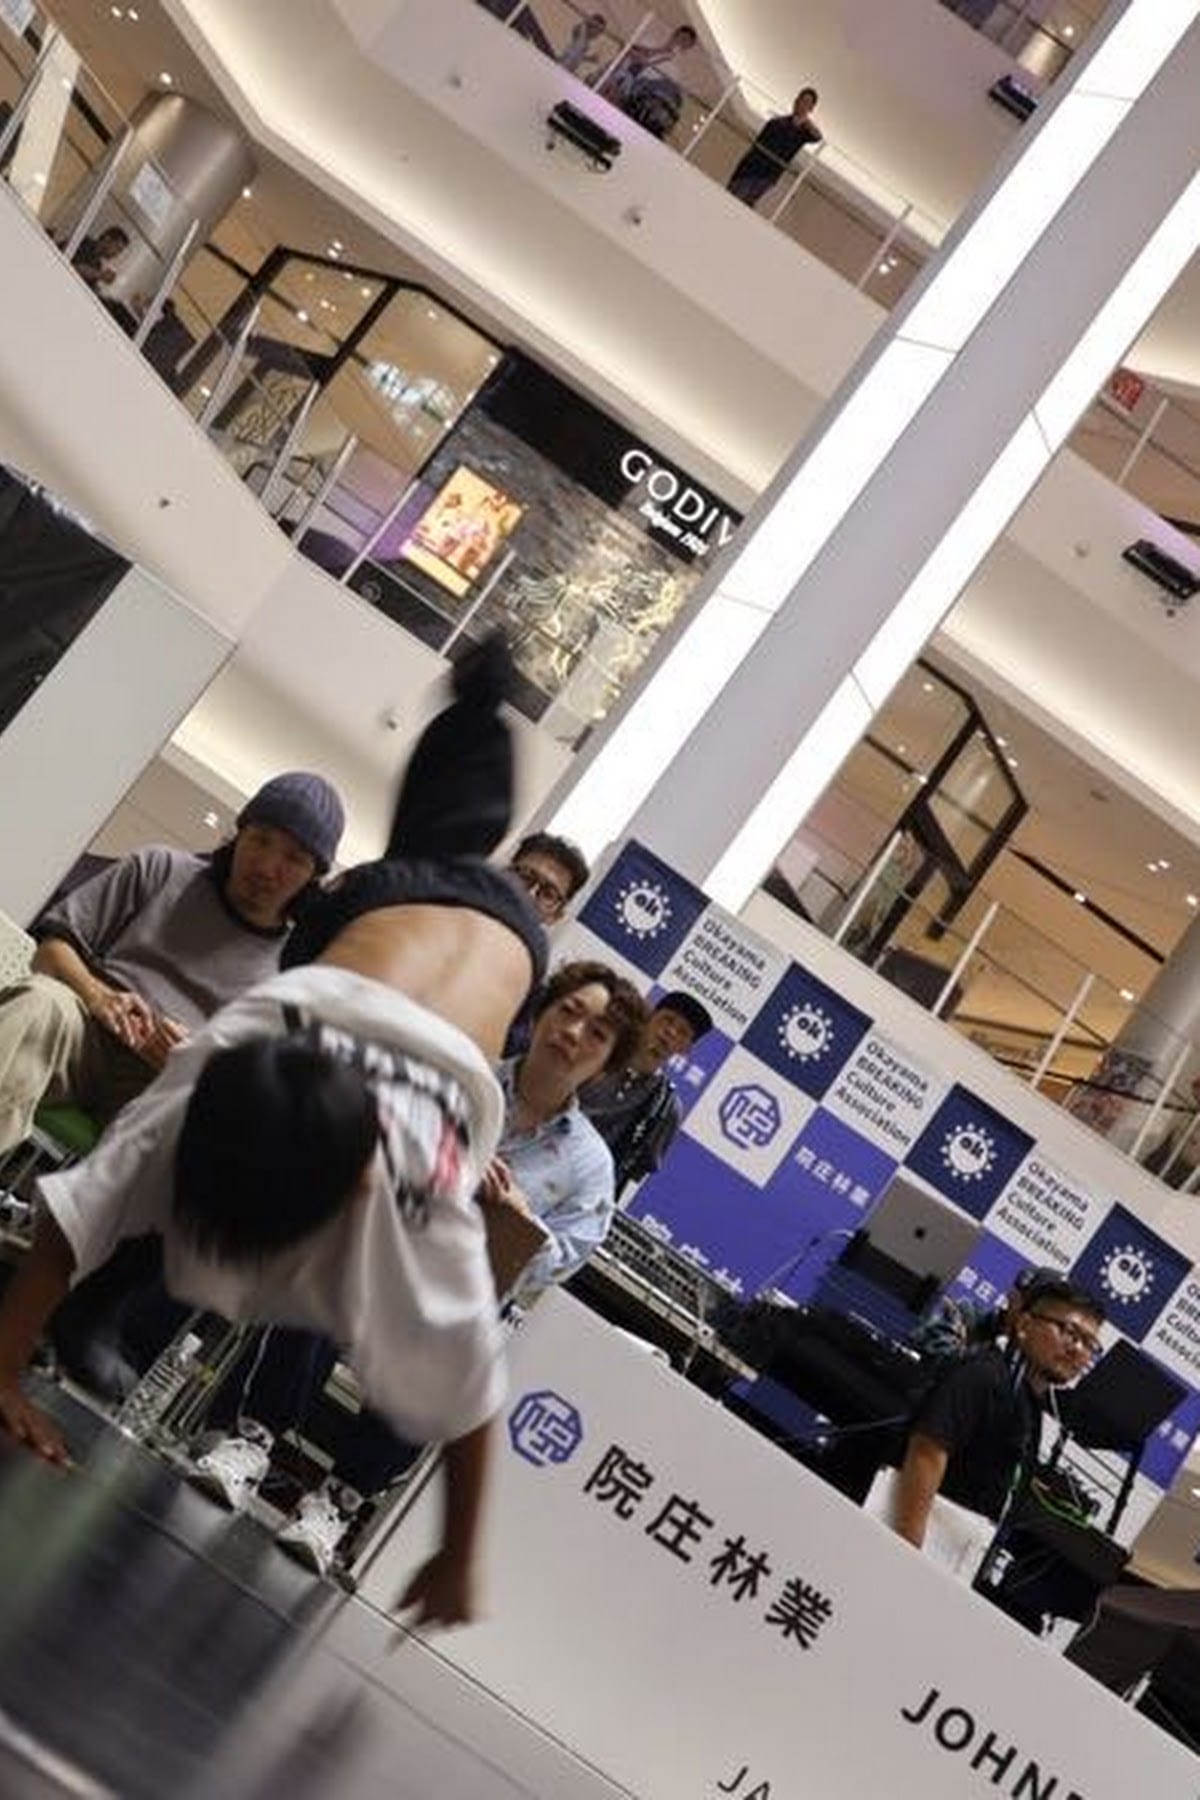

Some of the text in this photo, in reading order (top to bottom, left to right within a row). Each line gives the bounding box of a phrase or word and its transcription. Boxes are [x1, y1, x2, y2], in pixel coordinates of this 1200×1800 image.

[683, 949, 733, 990] Culture
[693, 933, 762, 989] BREAKING
[703, 919, 766, 971] Okayama
[672, 964, 749, 1025] Association
[846, 1071, 897, 1112] Culture
[856, 1056, 924, 1110] BREAKING
[867, 1041, 929, 1092] Okayama
[835, 1086, 911, 1146] Association
[1007, 1191, 1057, 1232] Culture
[1017, 1175, 1086, 1232] BREAKING
[1028, 1161, 1089, 1213] Okayama
[996, 1206, 1071, 1266] Association
[582, 1444, 833, 1650] 院庄林業
[900, 1688, 1085, 1800] JOHN
